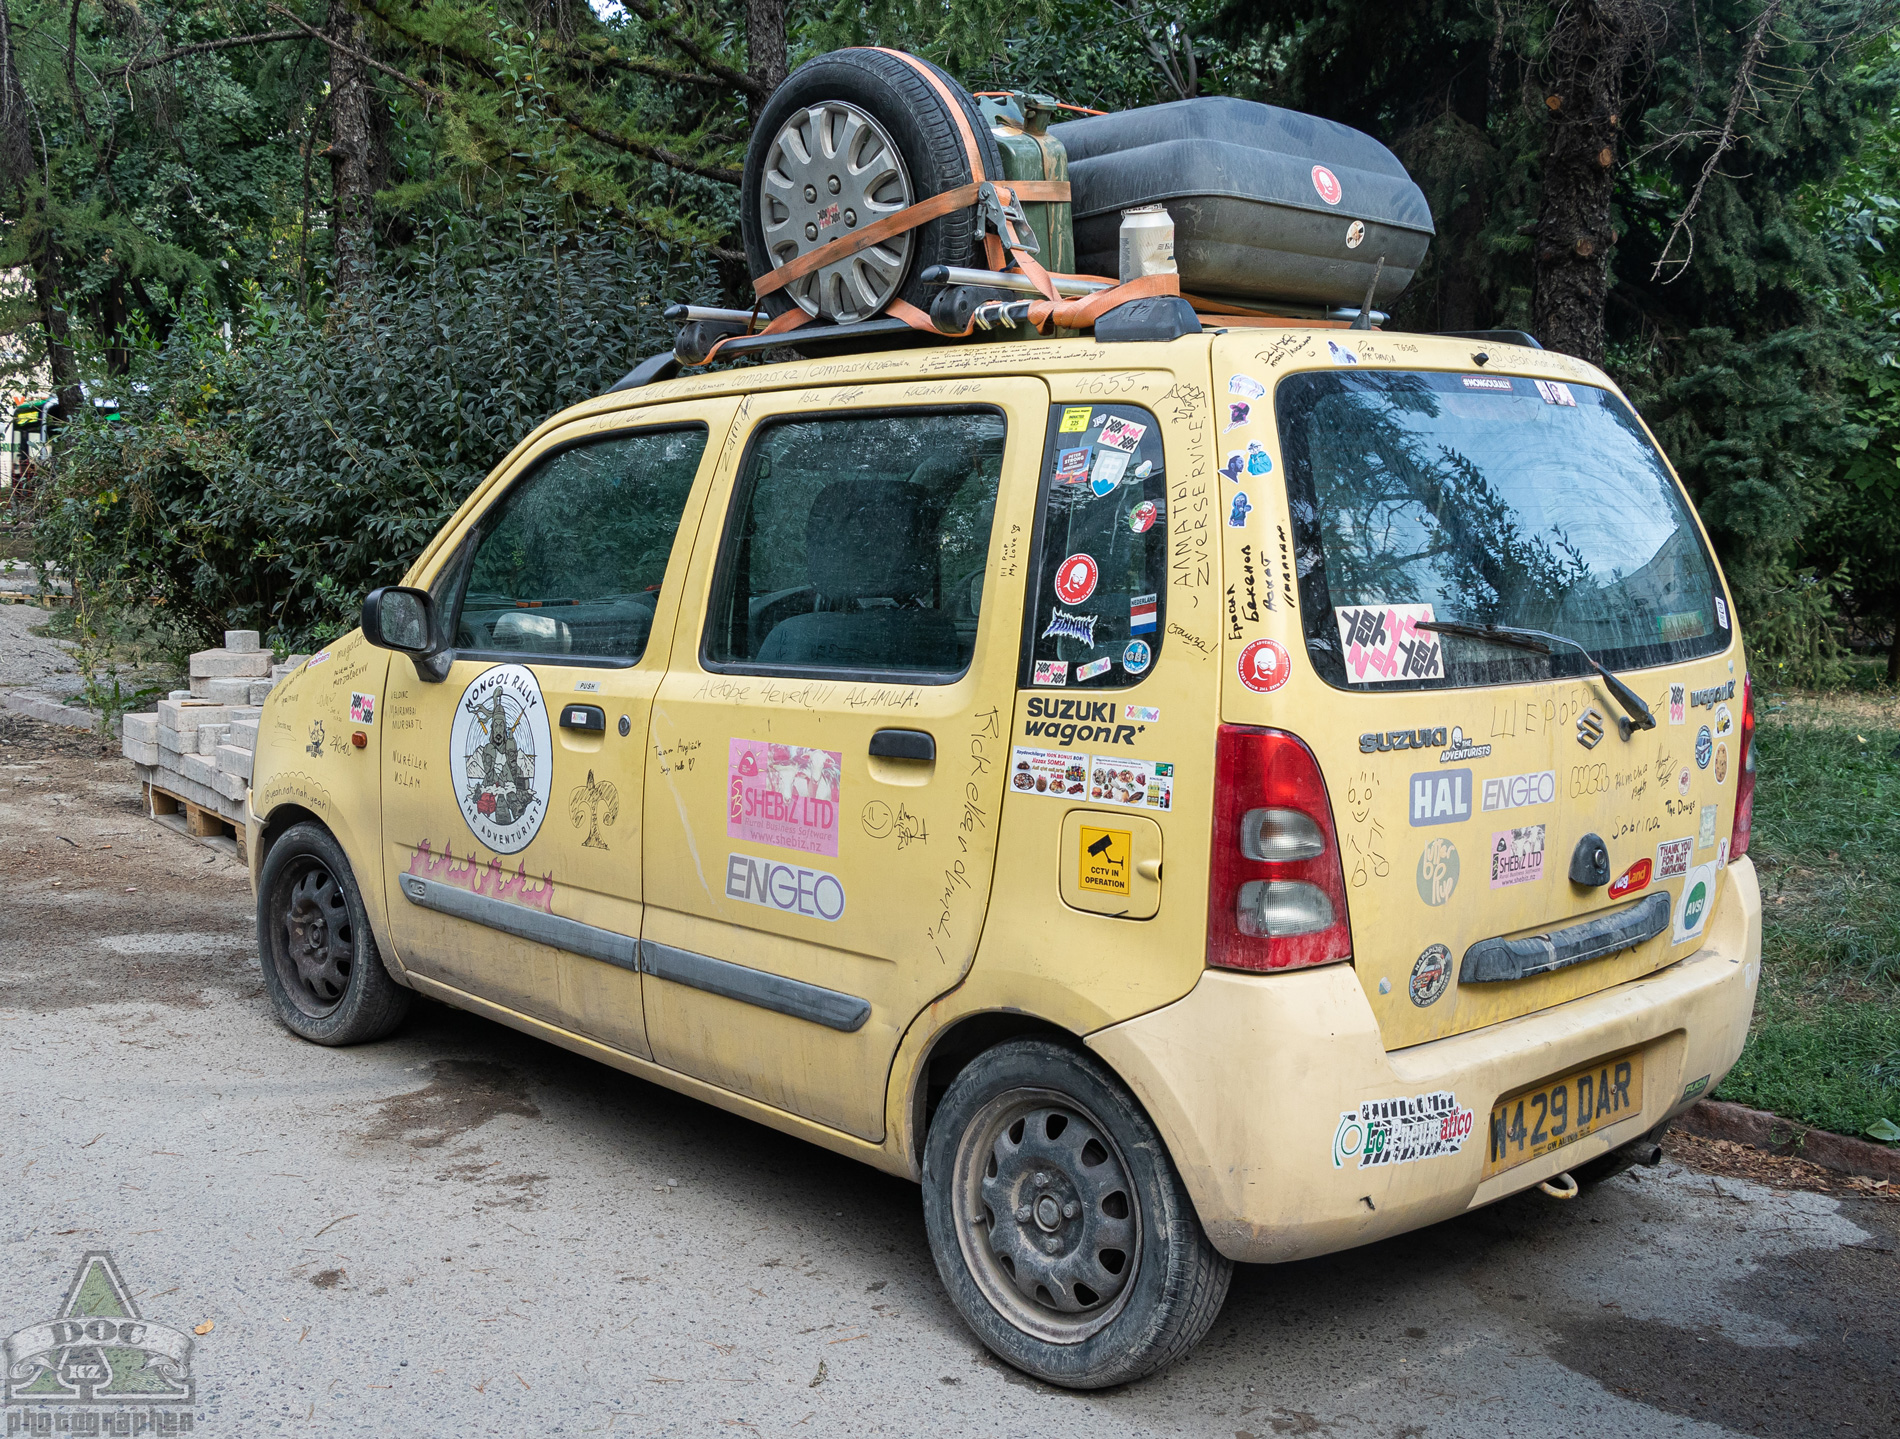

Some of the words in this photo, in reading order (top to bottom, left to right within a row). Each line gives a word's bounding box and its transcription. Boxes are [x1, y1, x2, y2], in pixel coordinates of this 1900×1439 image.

[465, 672, 510, 708] MONGOL
[511, 674, 537, 709] RALLY
[580, 682, 596, 690] PUSH
[1027, 697, 1116, 724] SUZUKI
[1358, 726, 1448, 753] SUZUKI
[1048, 758, 1066, 766] SOMSA
[1440, 744, 1491, 763] ADVENTURISTS
[1414, 776, 1468, 819] HAL
[1483, 772, 1554, 811] ENGEO
[464, 798, 477, 824] THE
[481, 798, 542, 845] ADVENTURISTS
[804, 798, 834, 830] LTD
[744, 818, 764, 829] Rural
[766, 820, 796, 834] Business
[798, 825, 832, 841] Software
[750, 830, 822, 852] www.shebiz.nz
[1660, 844, 1680, 857] THANK
[1680, 840, 1692, 852] YOU
[1528, 850, 1542, 868] LTD
[1660, 862, 1687, 876] SMOKING
[1662, 854, 1674, 866] FOR
[1676, 852, 1688, 863] NOT
[1085, 876, 1124, 889] OPERATION
[1091, 866, 1110, 876] CCTV
[1112, 869, 1119, 878] IN
[726, 855, 845, 920] ENGEO
[1686, 898, 1704, 916] AVSI
[1489, 1085, 1568, 1163] W429
[1577, 1061, 1632, 1124] DAR
[1363, 1122, 1385, 1154] Lo
[1388, 1106, 1472, 1151] Pneumatico
